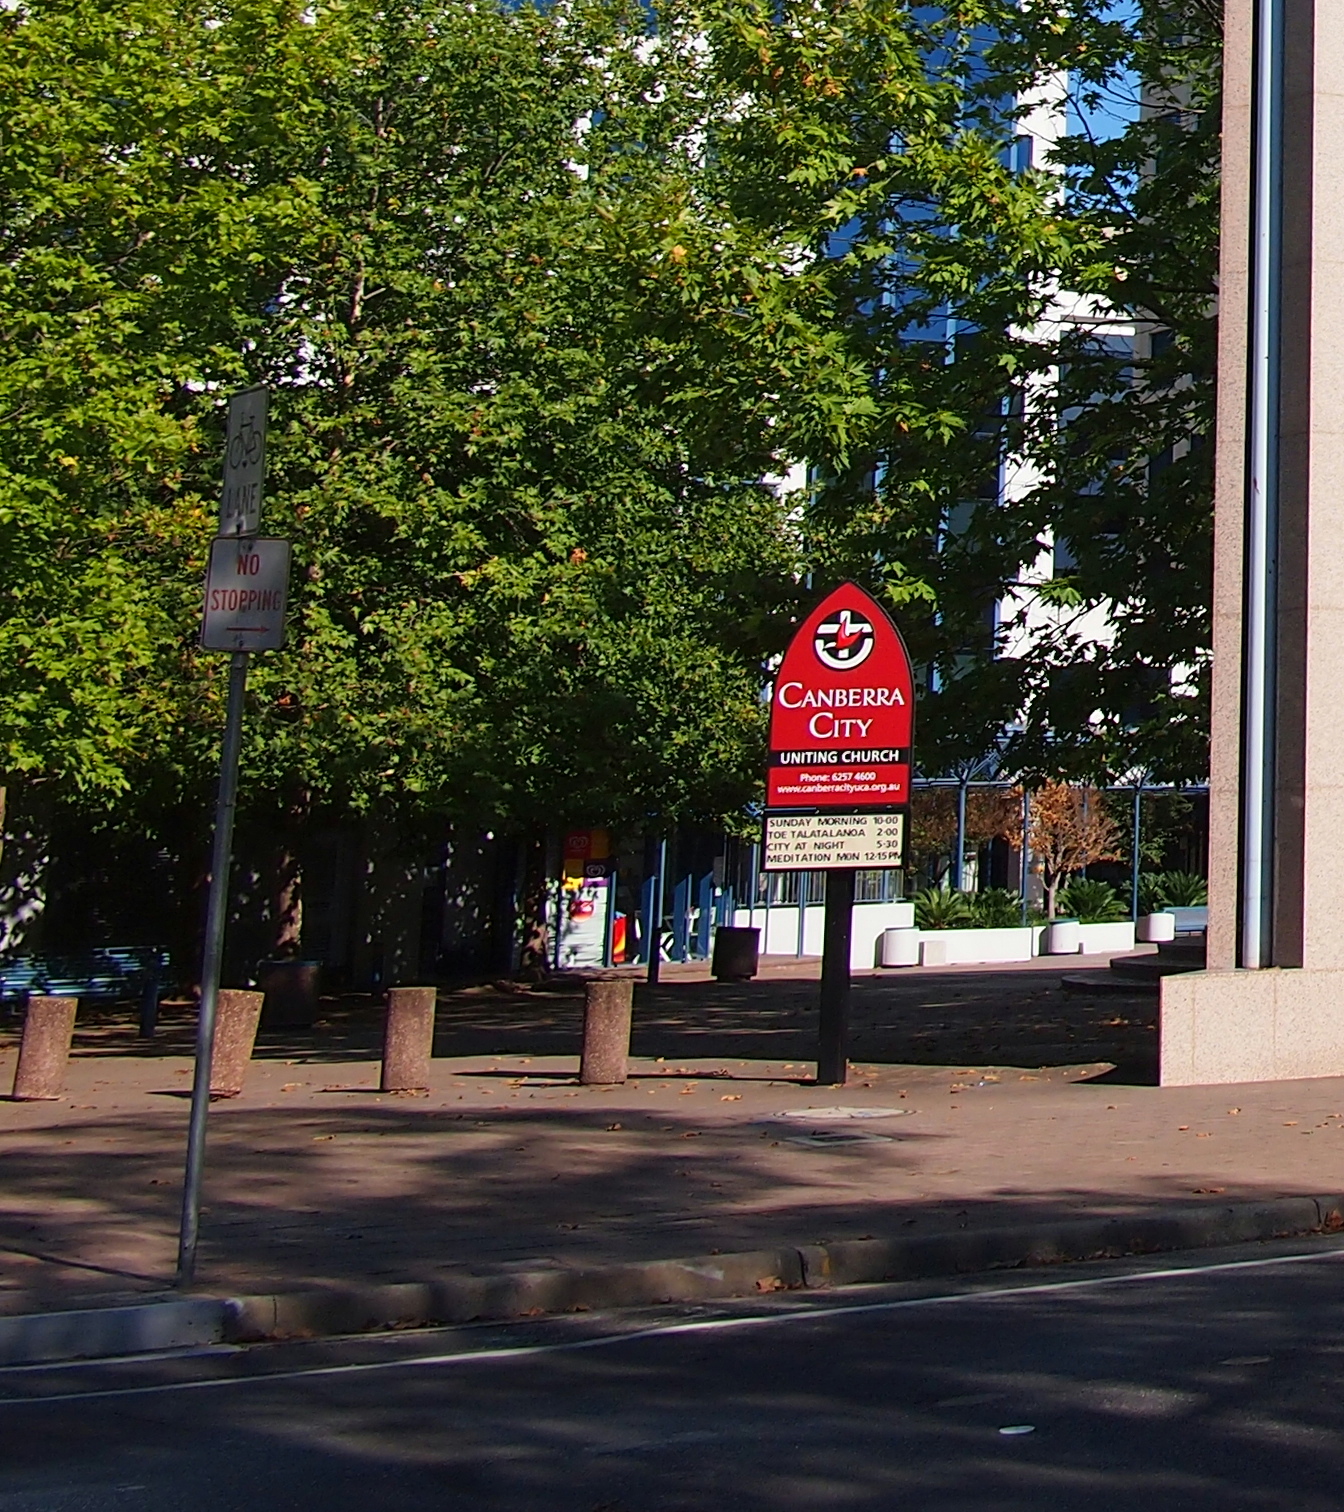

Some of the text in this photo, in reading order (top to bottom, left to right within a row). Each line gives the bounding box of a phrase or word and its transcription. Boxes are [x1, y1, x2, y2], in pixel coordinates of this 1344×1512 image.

[226, 482, 259, 519] LANE
[236, 553, 260, 576] NO
[210, 589, 281, 611] STOPPING
[780, 749, 900, 765] UNITING CHURCH
[799, 771, 877, 783] Phone: 6257 4600
[769, 818, 812, 828] SUNDAY
[817, 816, 868, 827] MORNING
[767, 830, 787, 840] TOE
[791, 828, 866, 839] TALATALANOA
[766, 842, 790, 852] CITY
[795, 841, 807, 851] AT
[813, 840, 845, 851] NIGHT
[766, 852, 832, 863] MEDITATION
[836, 852, 860, 862] MON
